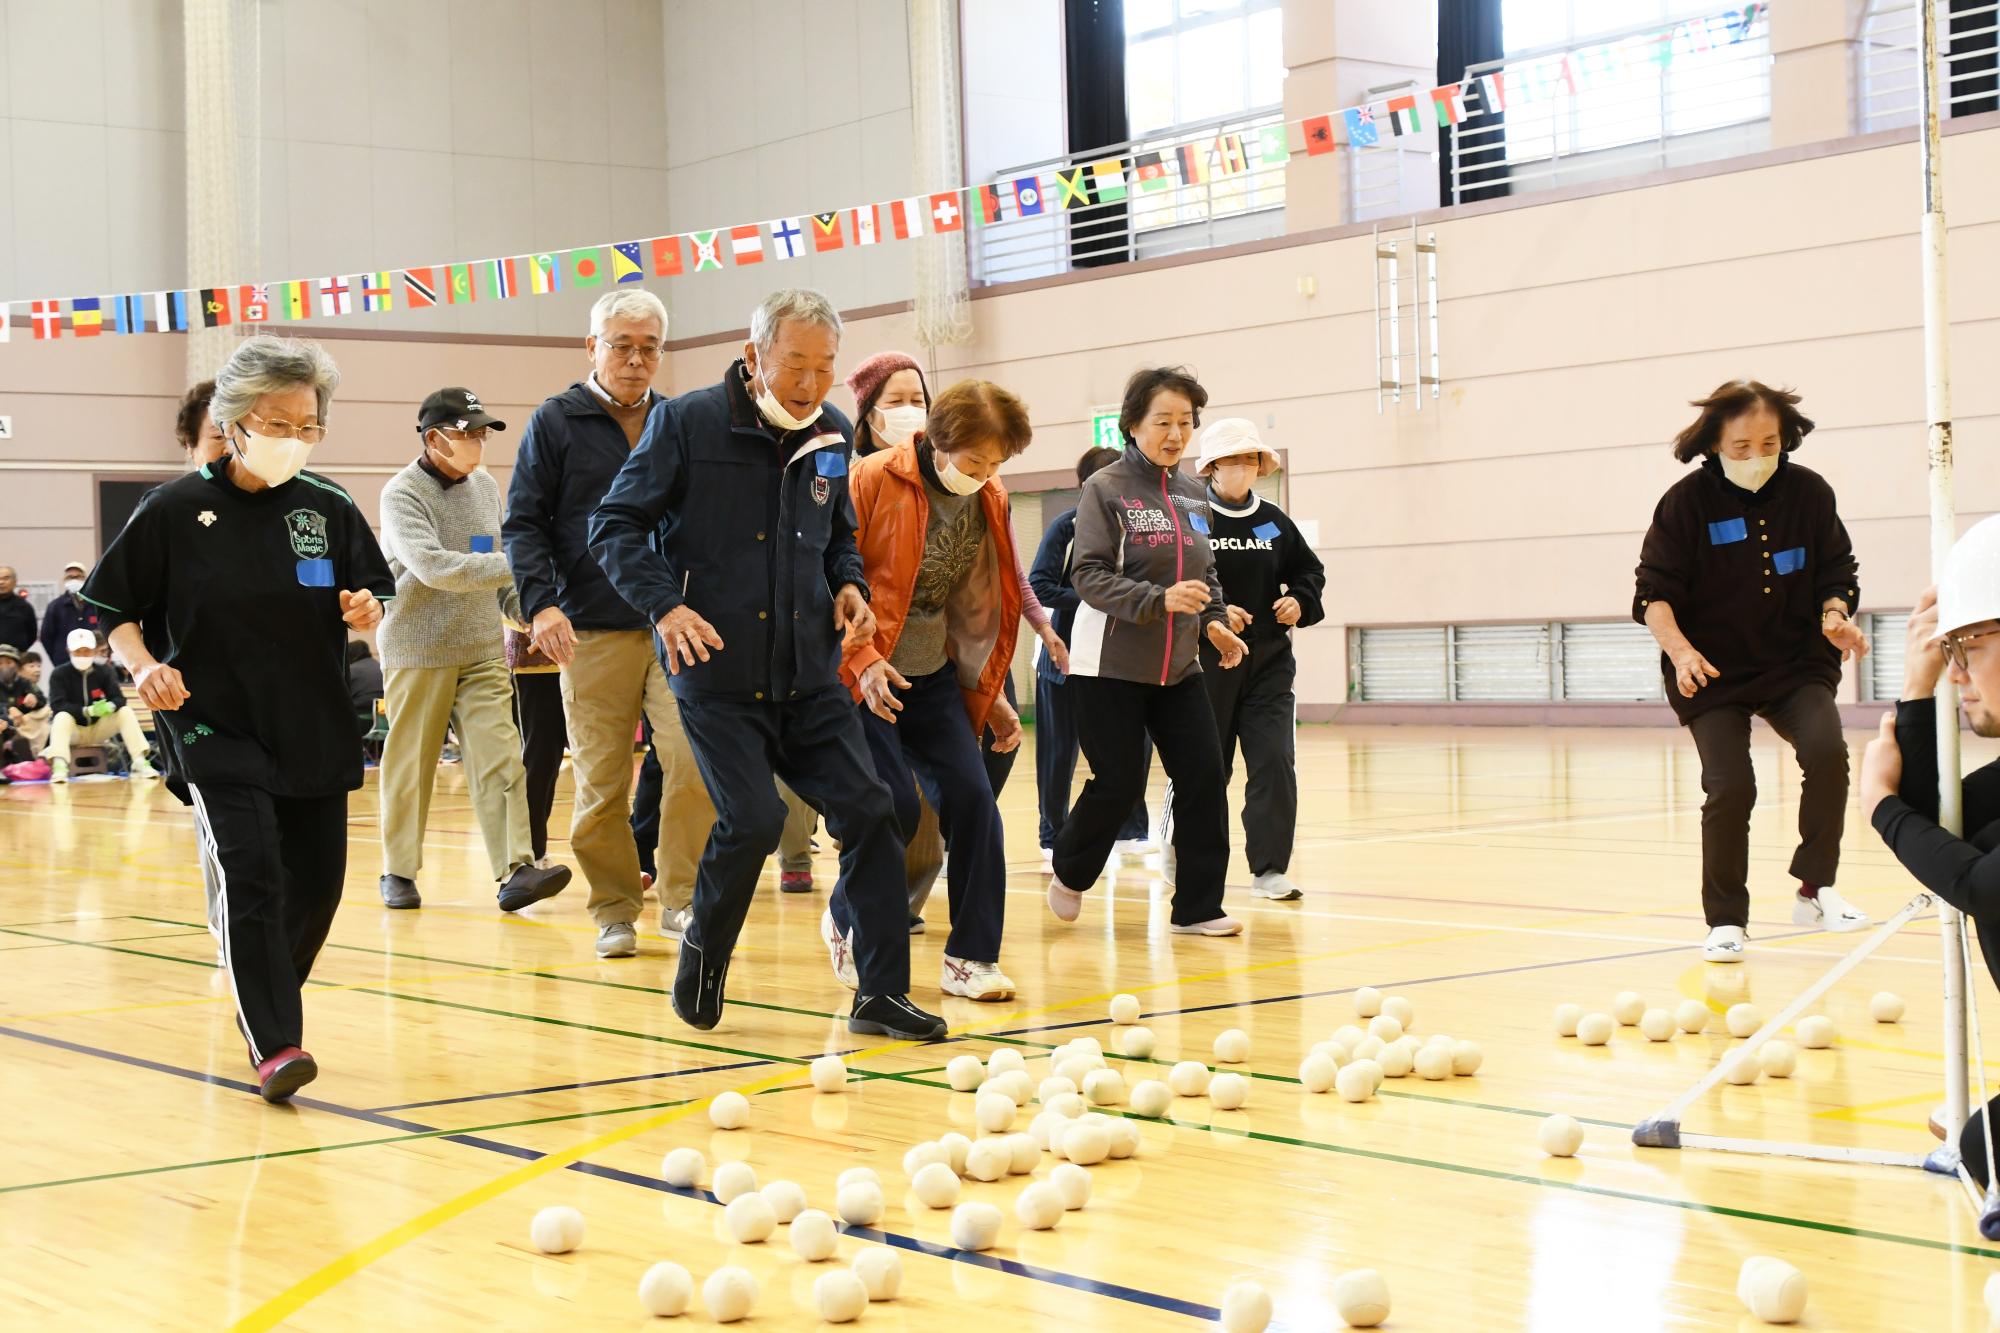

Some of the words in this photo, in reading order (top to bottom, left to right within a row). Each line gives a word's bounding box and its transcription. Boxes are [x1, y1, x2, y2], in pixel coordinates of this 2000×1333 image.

[1120, 495, 1144, 509] La
[1127, 509, 1165, 519] corsa
[295, 535, 324, 546] Sports
[1208, 538, 1273, 551] DECLARE
[297, 543, 324, 554] Magic
